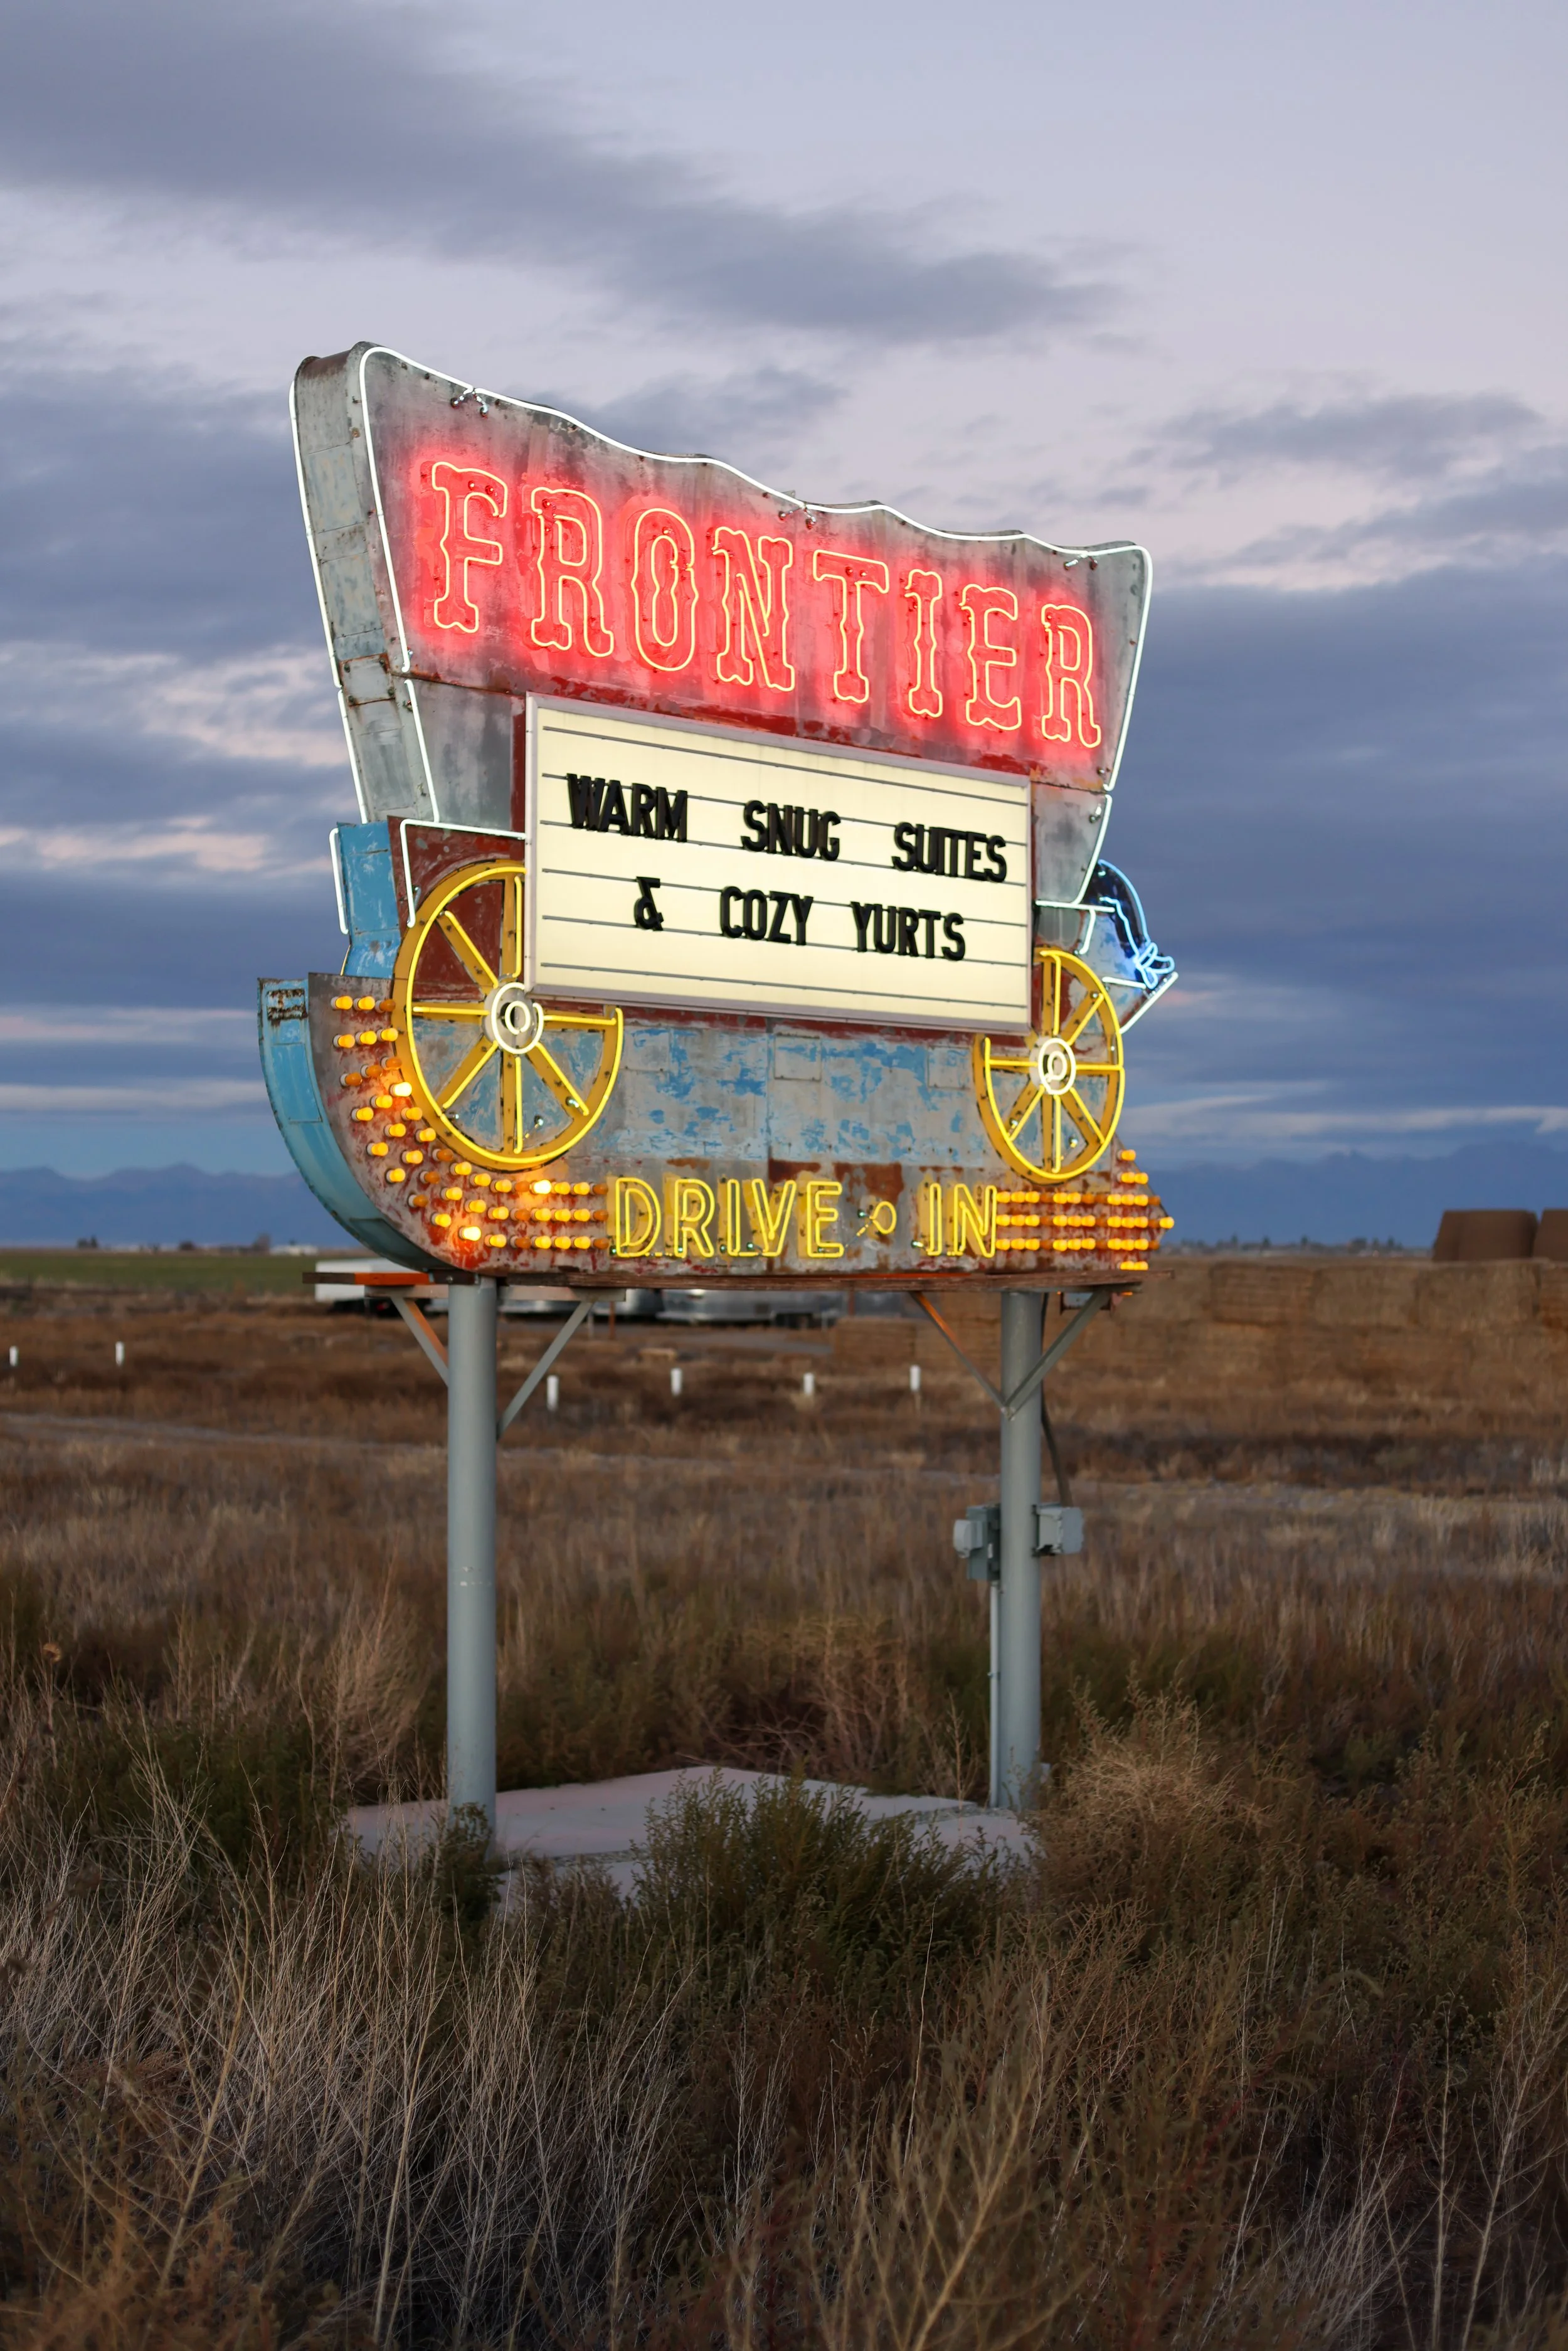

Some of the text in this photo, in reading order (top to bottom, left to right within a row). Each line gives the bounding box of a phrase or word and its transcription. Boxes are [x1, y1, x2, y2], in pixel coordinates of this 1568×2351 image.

[430, 460, 1101, 749] FRONTIER
[566, 773, 1007, 883] WARM SNUG SUITES
[719, 886, 814, 946] COZY
[850, 901, 966, 961] YURTS
[615, 1177, 997, 1258] DRIVE IN
